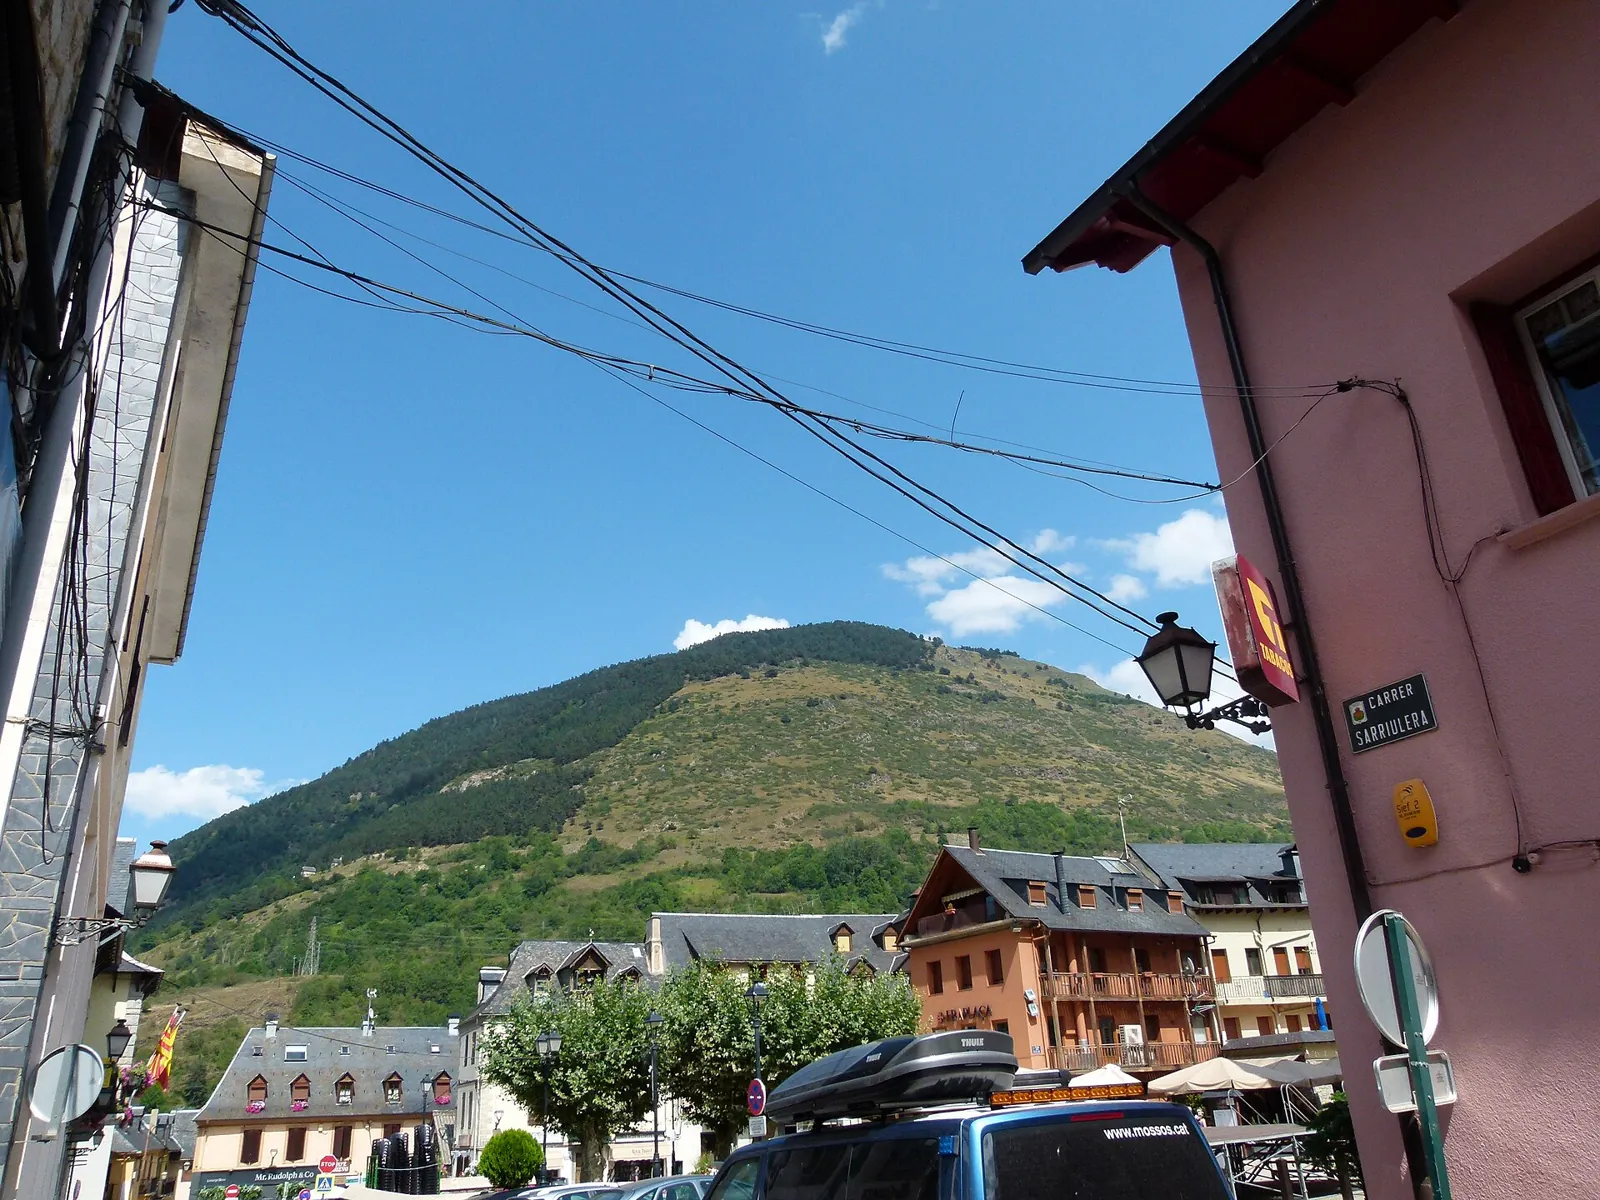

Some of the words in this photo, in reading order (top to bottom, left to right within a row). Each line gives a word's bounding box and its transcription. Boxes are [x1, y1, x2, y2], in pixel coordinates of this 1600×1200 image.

[1259, 642, 1294, 679] TABACOS
[1368, 683, 1414, 709] CARRER
[1355, 709, 1429, 746] SARRIULERA
[961, 1038, 984, 1047] THULE
[1103, 1122, 1190, 1140] www.mossos.cat
[254, 1173, 267, 1181] Mr.
[267, 1171, 298, 1181] Rudolph
